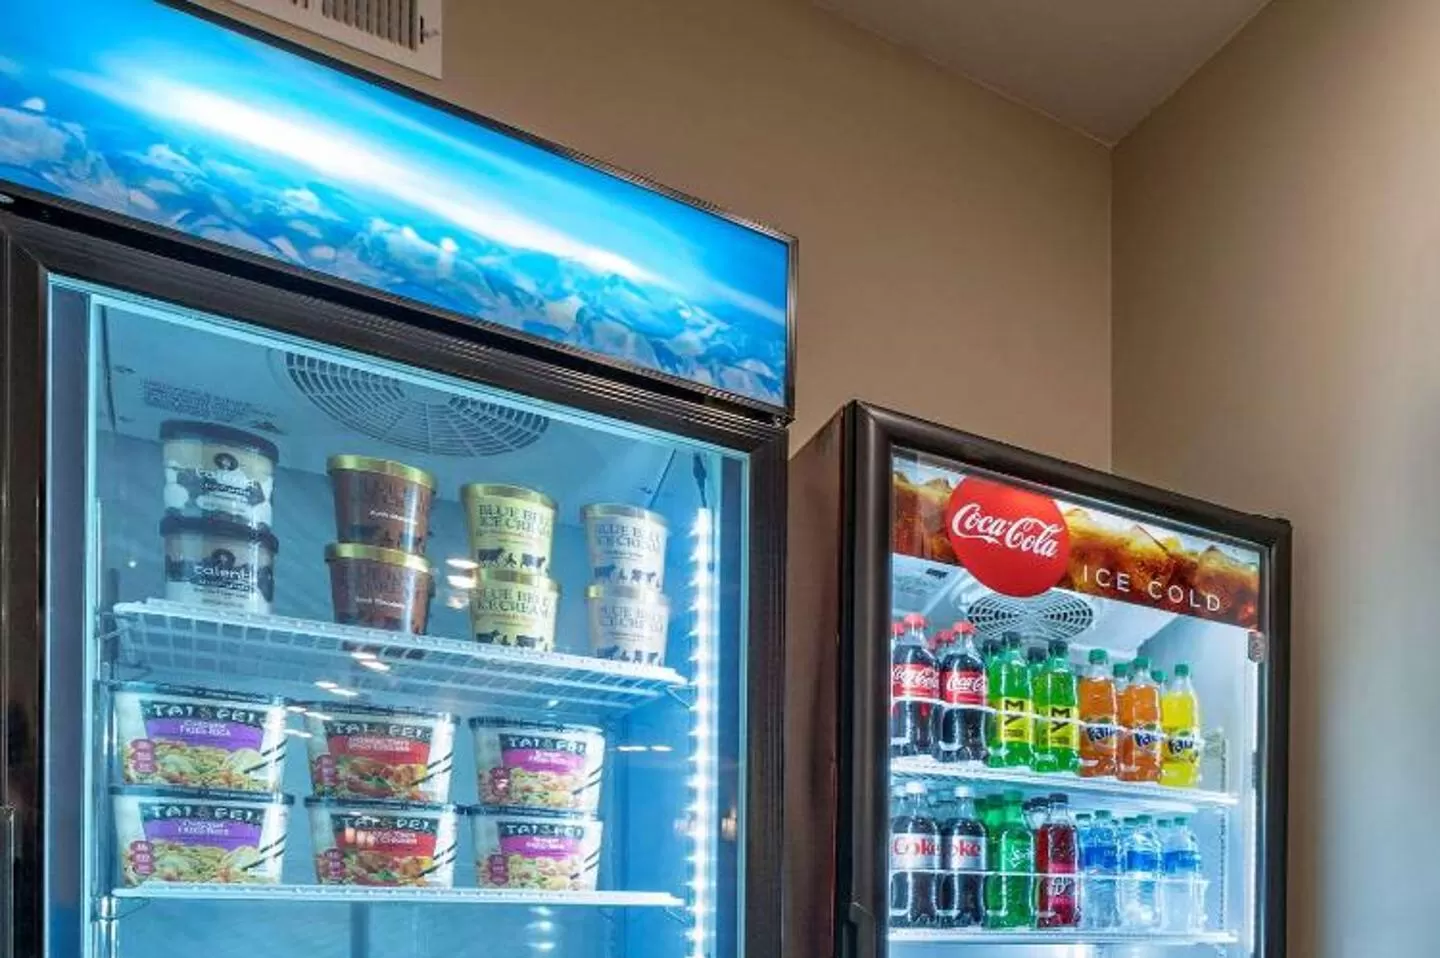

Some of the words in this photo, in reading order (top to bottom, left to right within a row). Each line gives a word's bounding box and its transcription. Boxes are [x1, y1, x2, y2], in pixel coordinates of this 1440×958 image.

[952, 502, 1064, 558] Coca-Cola
[1083, 564, 1132, 592] ICE
[1148, 579, 1222, 613] COLD
